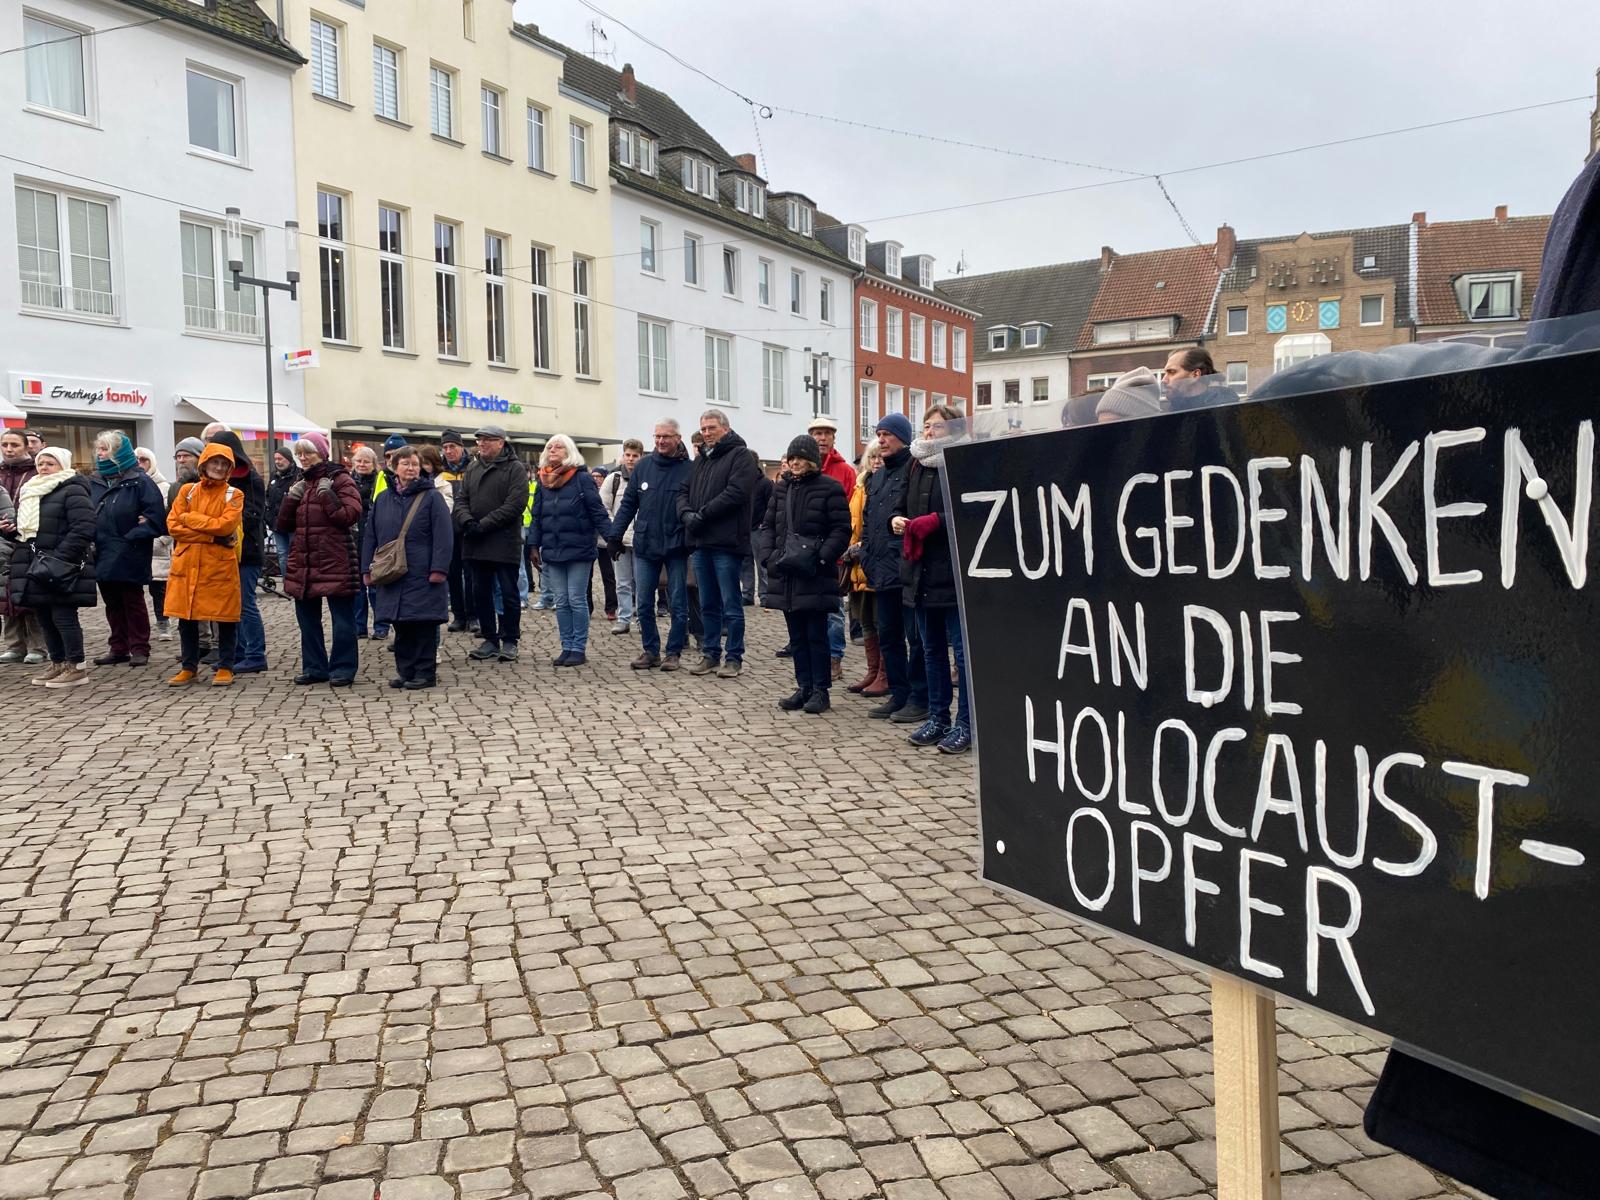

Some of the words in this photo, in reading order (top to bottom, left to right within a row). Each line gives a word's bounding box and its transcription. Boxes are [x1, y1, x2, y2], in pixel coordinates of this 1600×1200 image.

[51, 386, 103, 405] Ernsting's
[106, 388, 147, 406] family
[961, 482, 1094, 580] ZUM
[1116, 419, 1595, 590] GEDENKEN
[1057, 597, 1148, 691] AN
[1183, 604, 1303, 717] DIE
[1025, 694, 1586, 901] HOLOCAUST-
[1065, 806, 1376, 1017] OPFER
